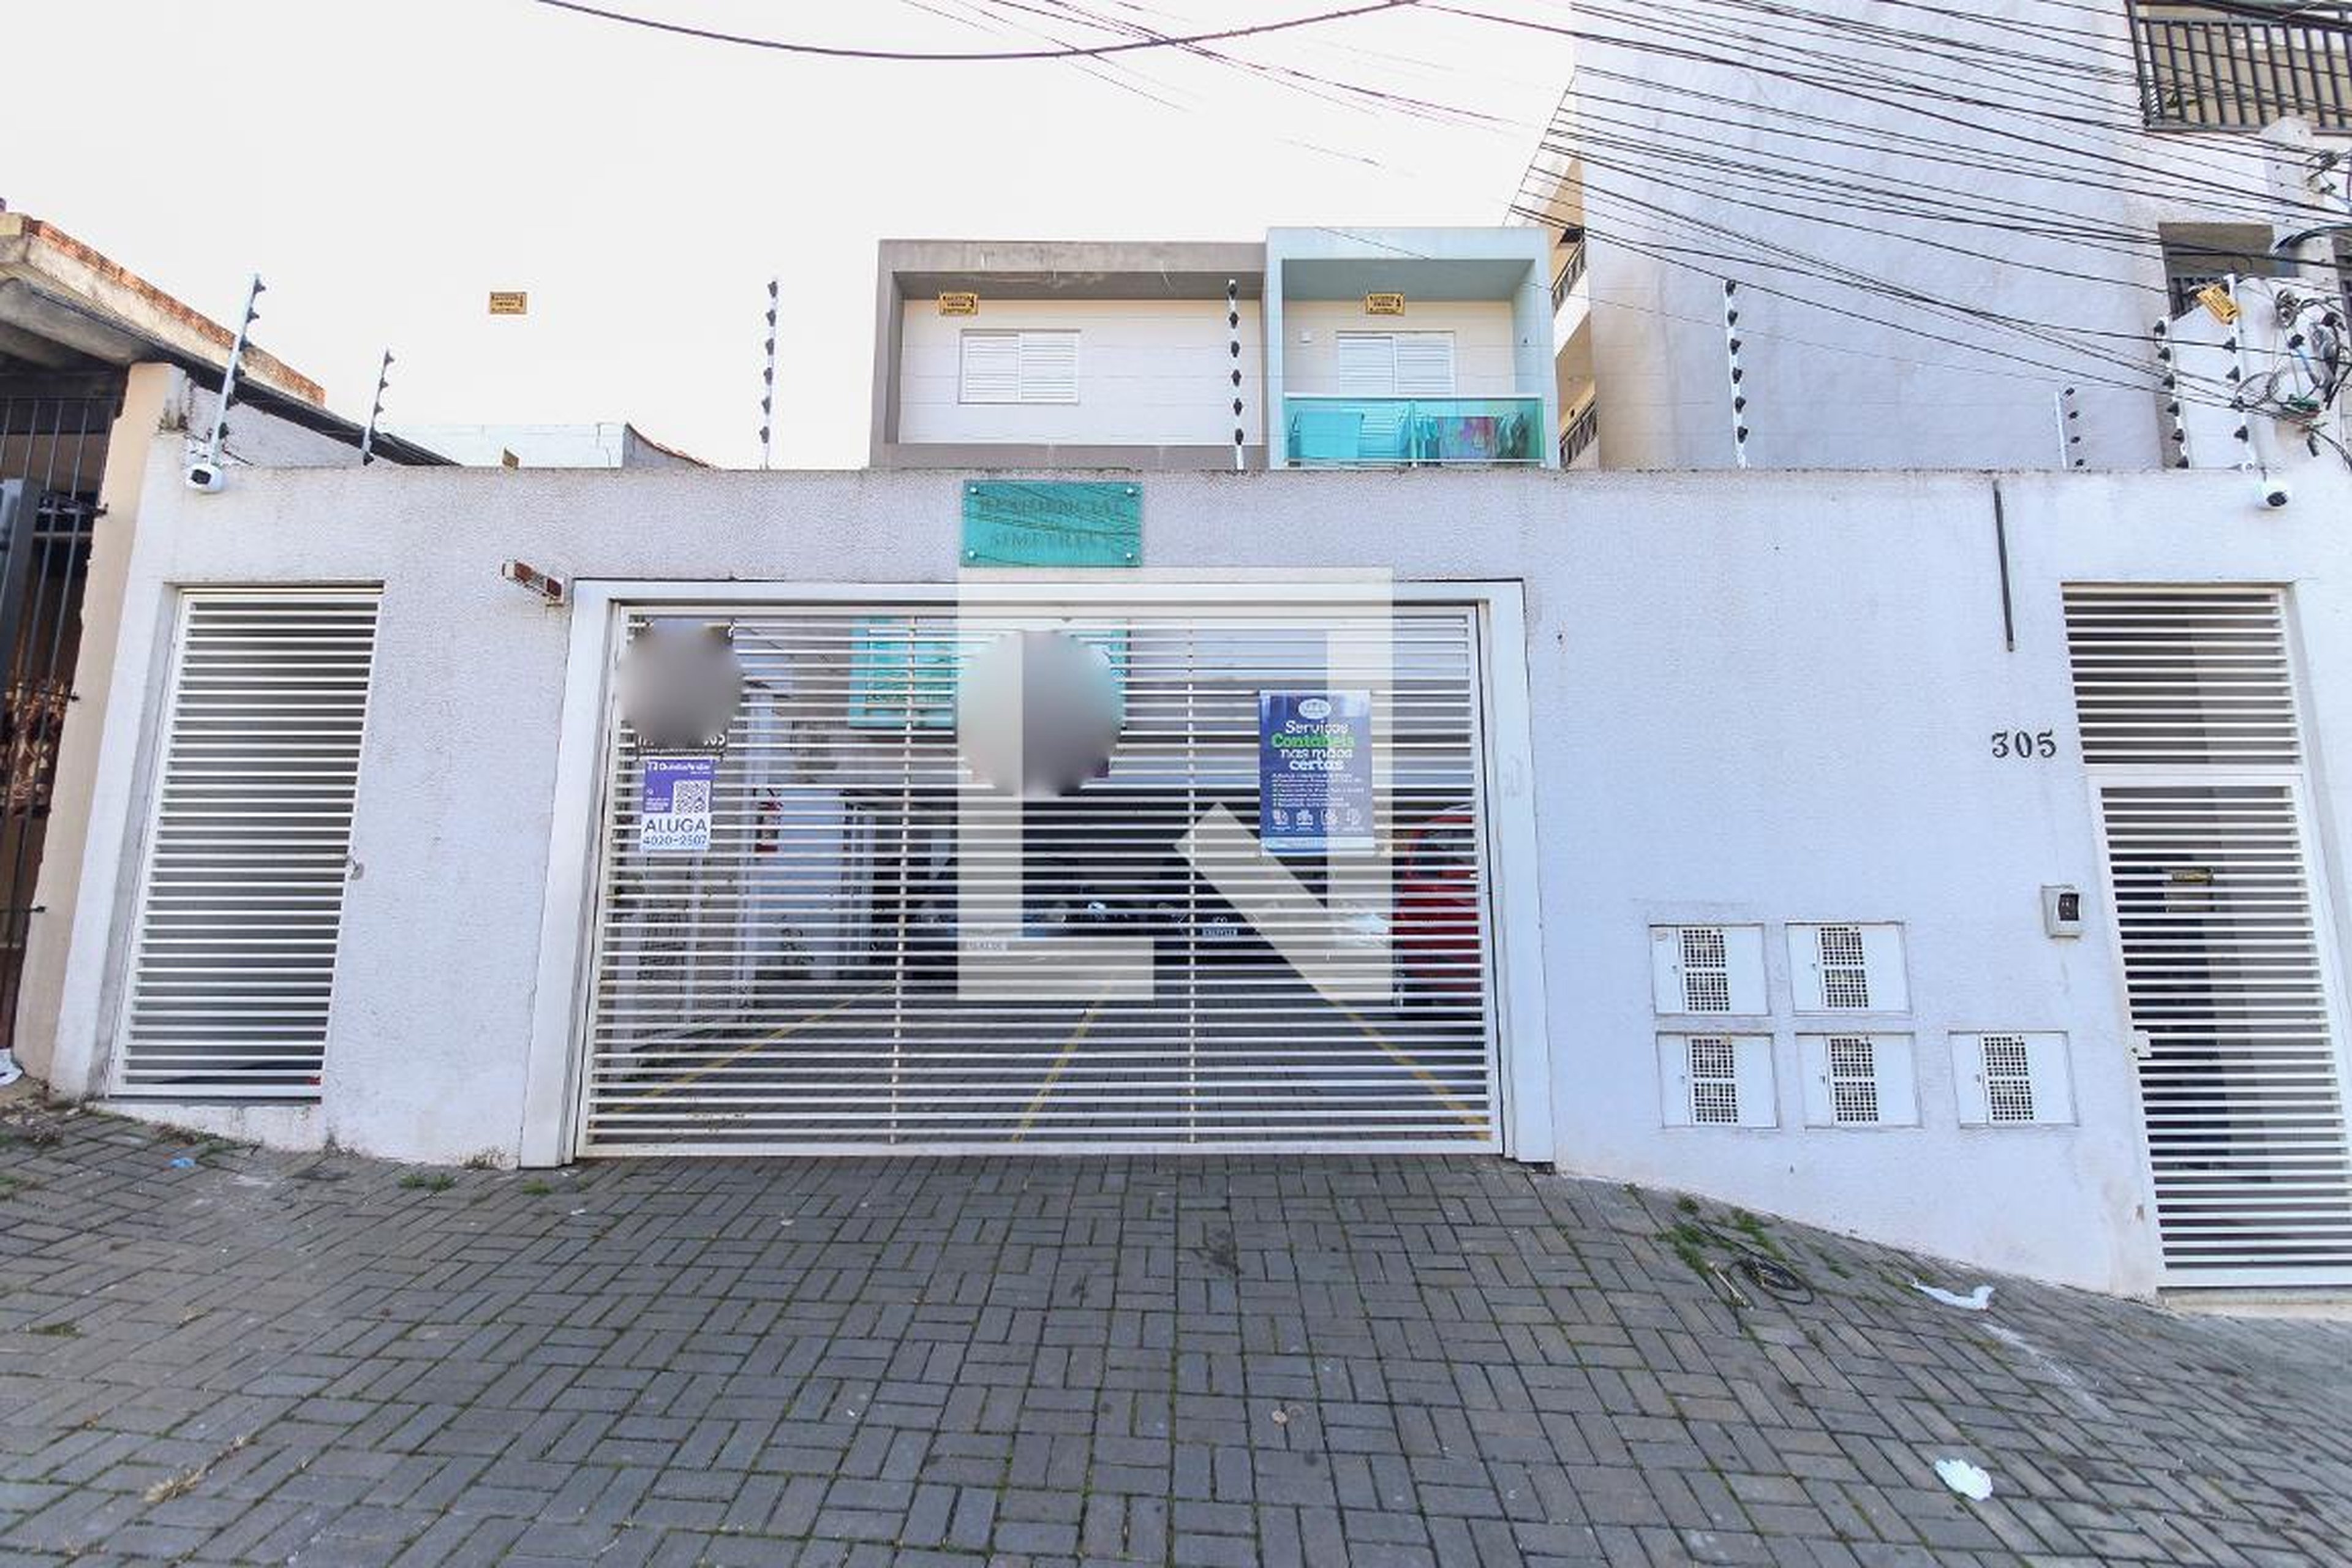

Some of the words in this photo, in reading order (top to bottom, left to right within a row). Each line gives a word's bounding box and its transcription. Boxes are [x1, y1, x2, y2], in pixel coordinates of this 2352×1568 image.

[1285, 720, 1349, 735] Serviços
[1991, 729, 2057, 758] 305
[1289, 760, 1344, 771] certas
[644, 818, 707, 833] ALUGA
